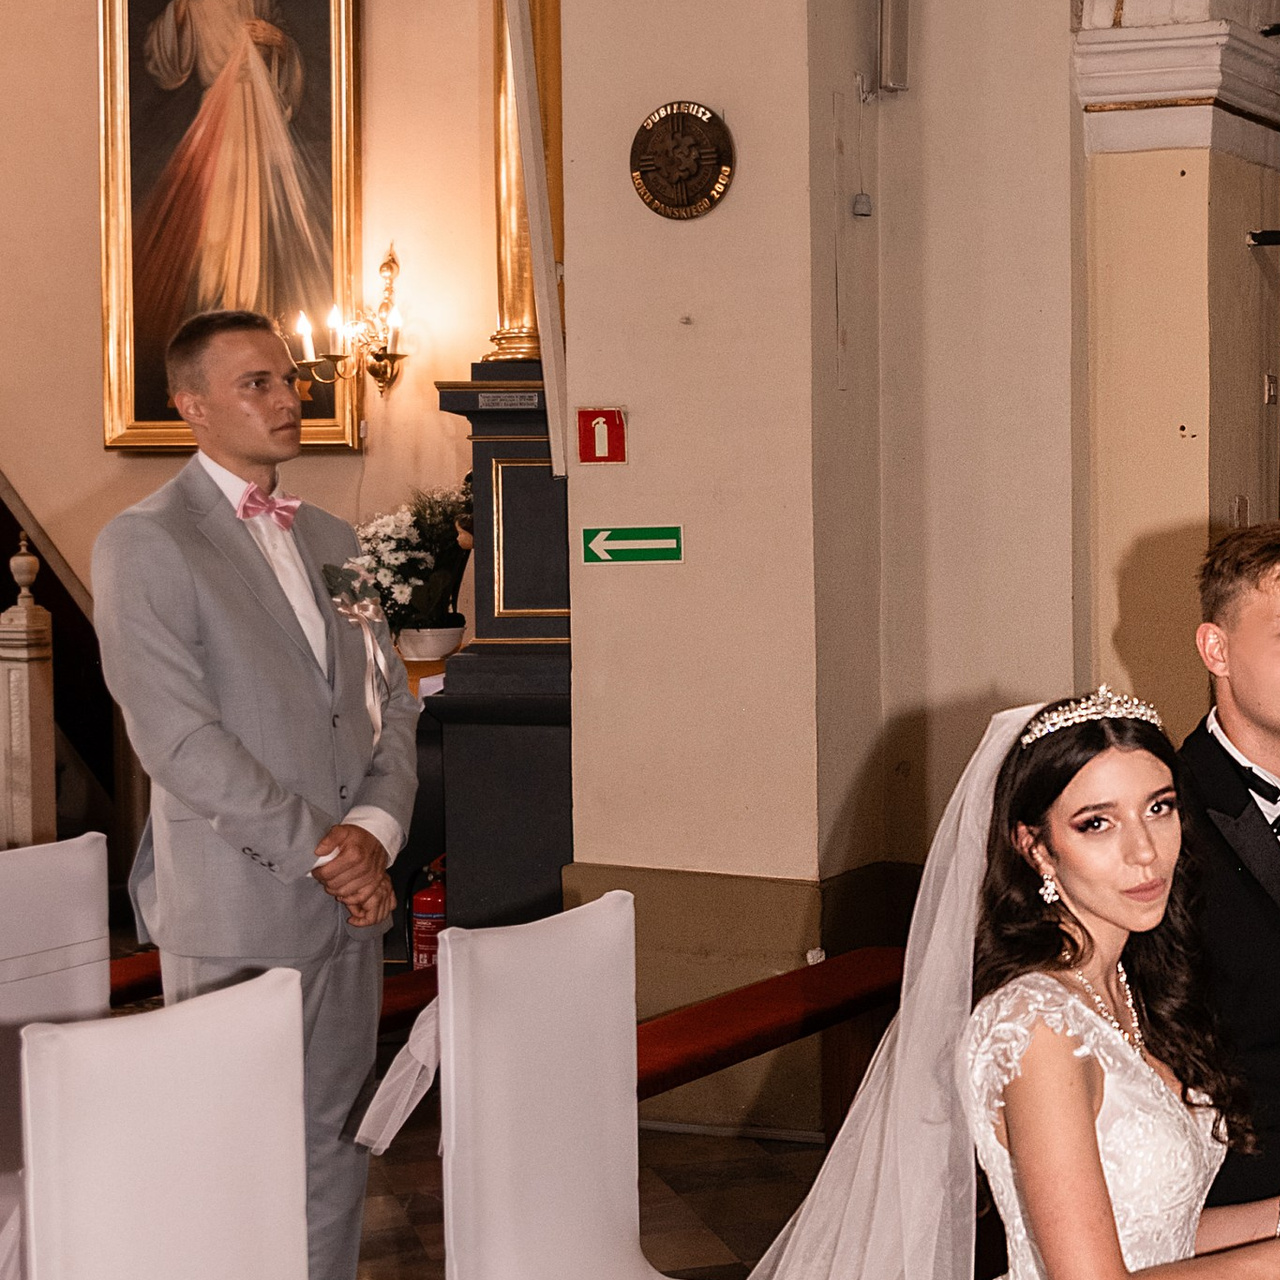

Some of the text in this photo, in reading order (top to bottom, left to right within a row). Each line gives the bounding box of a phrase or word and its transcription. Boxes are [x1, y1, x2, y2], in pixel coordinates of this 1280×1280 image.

[643, 103, 713, 130] JUBILEUSZ
[632, 170, 654, 204] ROKU
[710, 165, 731, 201] 2000
